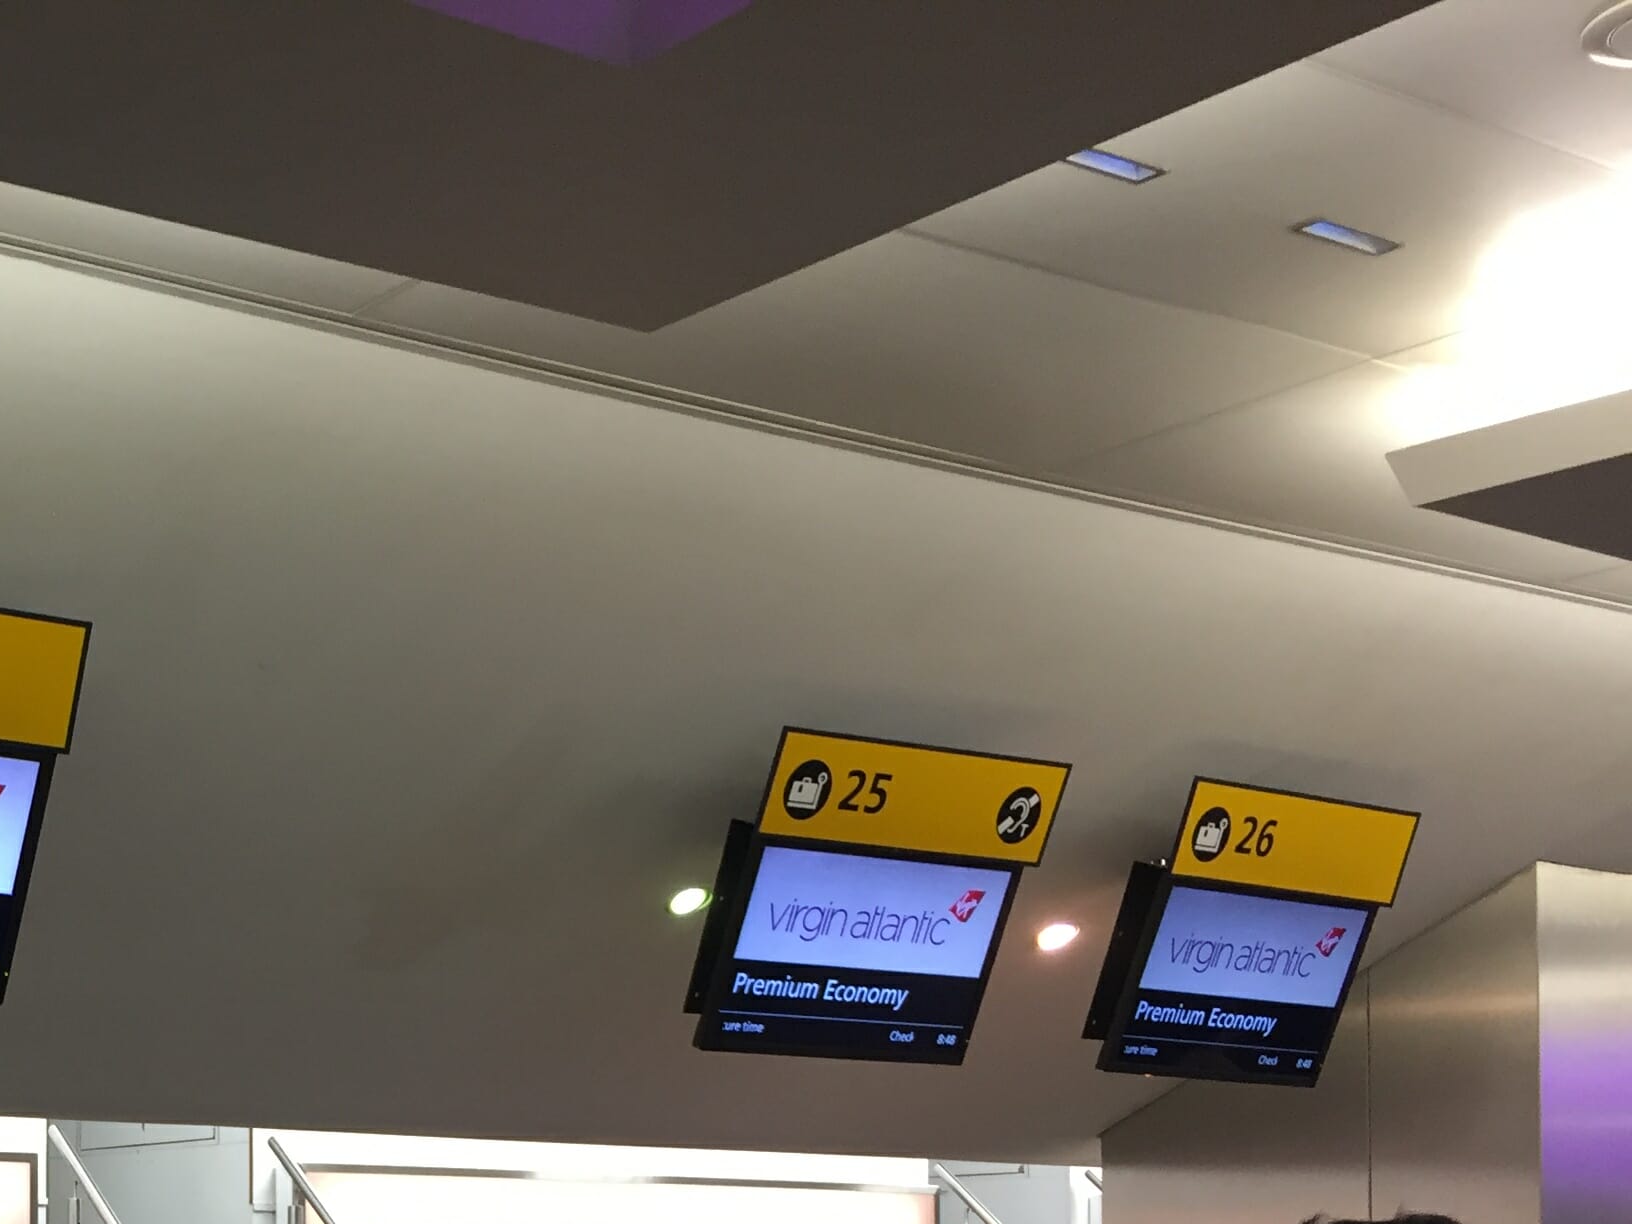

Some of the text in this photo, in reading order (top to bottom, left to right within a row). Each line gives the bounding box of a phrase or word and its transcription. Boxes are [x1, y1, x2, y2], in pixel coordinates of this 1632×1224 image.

[837, 769, 893, 814] 25
[1234, 816, 1278, 858] 26
[769, 899, 848, 943] virgin
[849, 905, 952, 947] atlantic
[1169, 934, 1234, 975] virgin
[1234, 940, 1317, 979] atlantic
[732, 972, 909, 1011] Premium Economy
[742, 1019, 765, 1034] time
[1134, 1000, 1279, 1037] Premium Economy
[936, 1033, 957, 1046] 8:48
